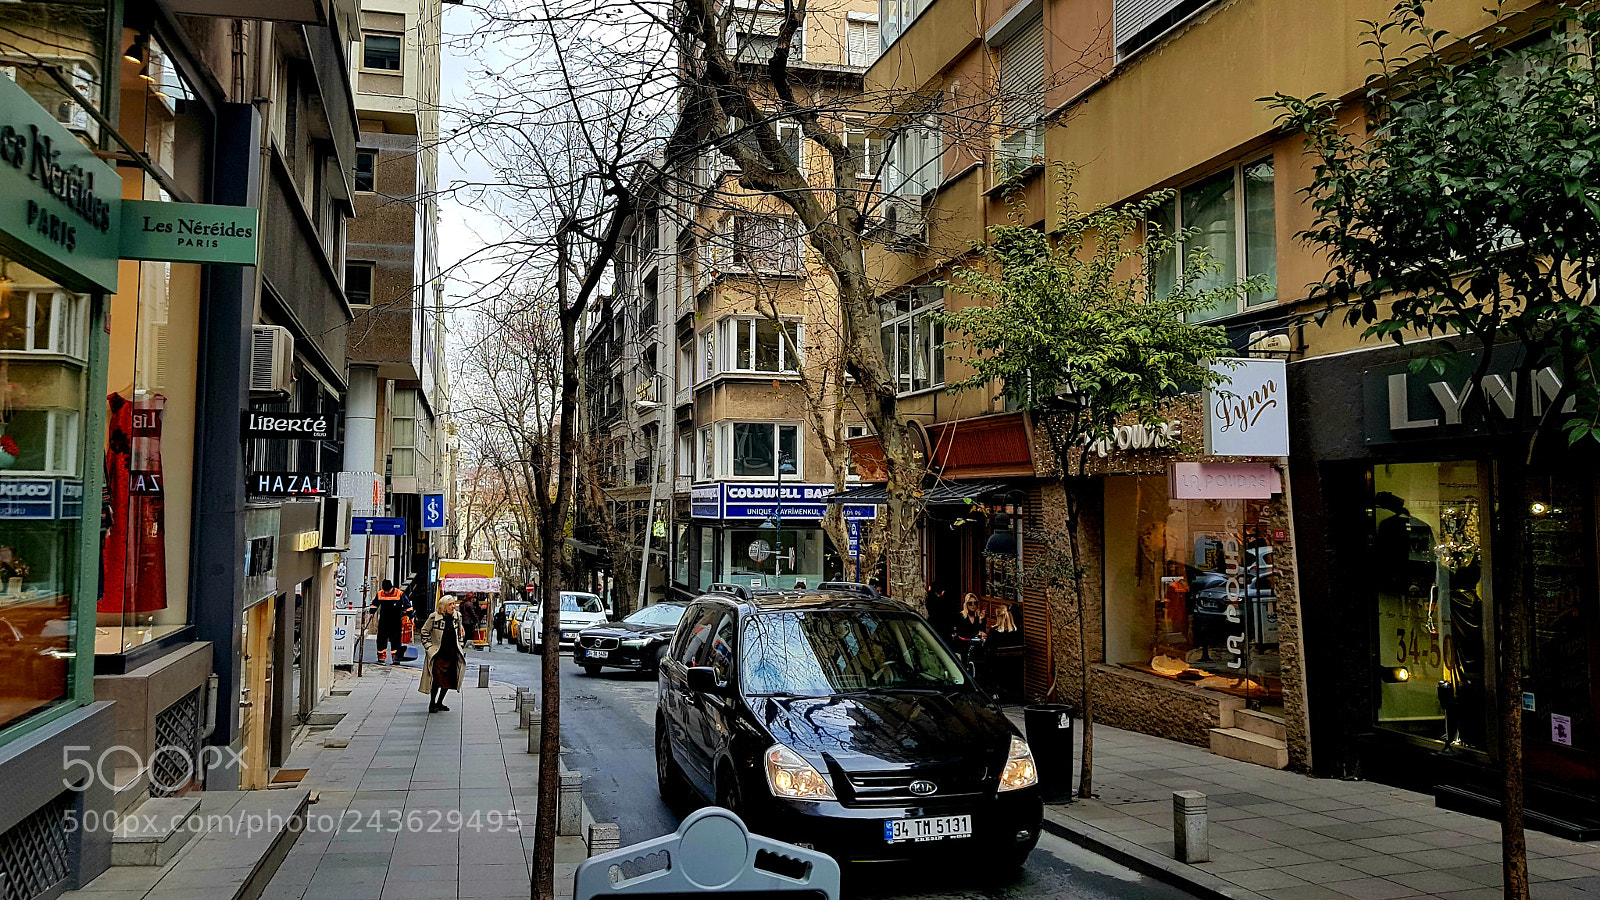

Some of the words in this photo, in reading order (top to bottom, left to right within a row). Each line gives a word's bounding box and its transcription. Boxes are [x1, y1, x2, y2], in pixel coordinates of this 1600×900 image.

[28, 200, 76, 252] PARIS
[143, 216, 172, 233] Les
[177, 218, 252, 238] Néréides
[178, 238, 218, 248] PARIS
[1215, 379, 1278, 433] Lynn
[259, 475, 327, 493] HAZAL
[728, 486, 801, 499] COLDWELL
[1182, 474, 1202, 491] LA
[1205, 474, 1266, 488] POUDRE
[1227, 632, 1245, 669] LA
[1396, 628, 1456, 671] 34-50
[893, 822, 909, 837] 34
[915, 820, 931, 836] TM
[936, 816, 967, 834] 5131
